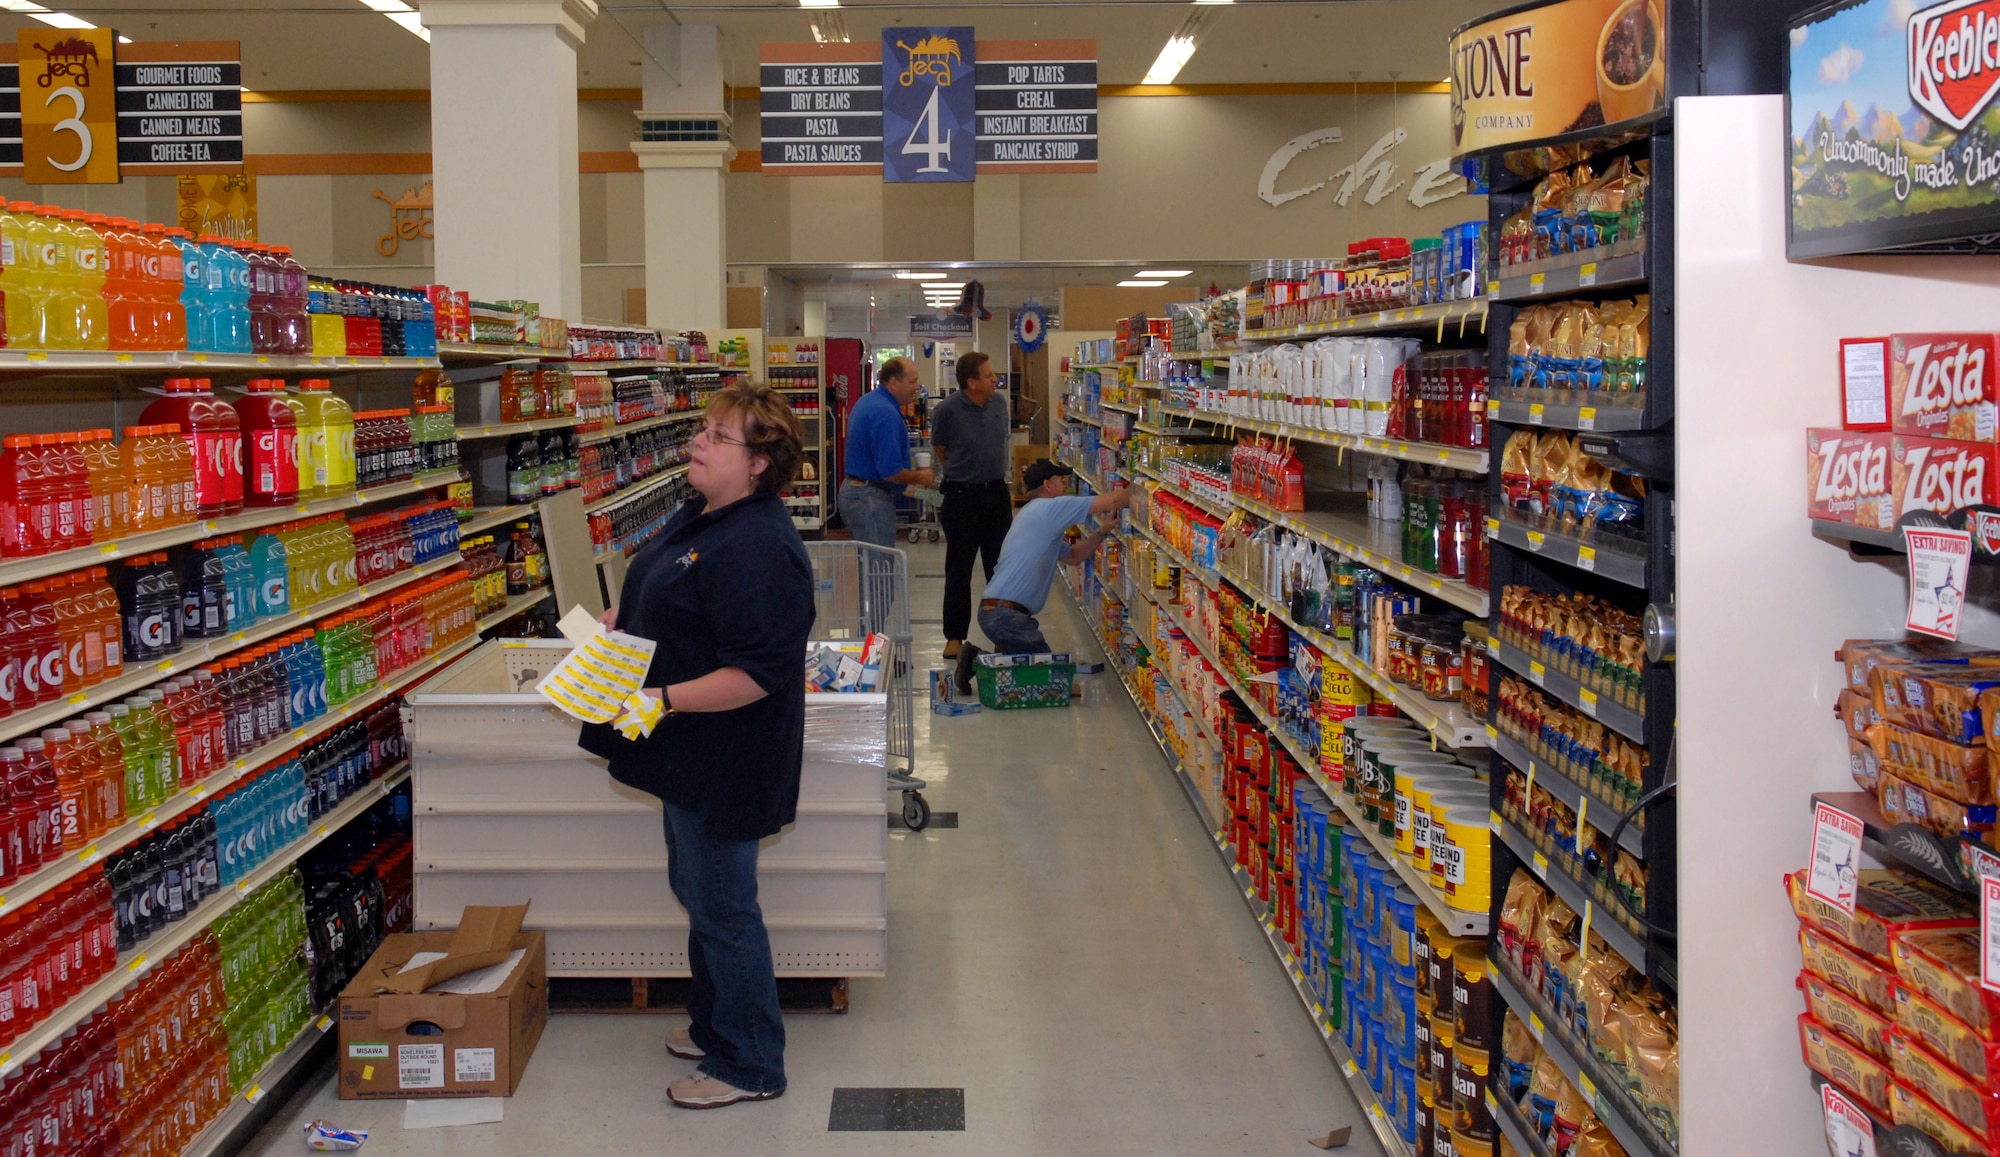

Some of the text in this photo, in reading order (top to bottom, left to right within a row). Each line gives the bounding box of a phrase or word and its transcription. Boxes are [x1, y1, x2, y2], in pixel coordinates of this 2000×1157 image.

[136, 66, 221, 85] GOURMET FOODS
[784, 67, 859, 85] RICE & BEANS
[1008, 66, 1064, 83] POP TARTS
[146, 93, 213, 110] CANNED FISH
[791, 93, 850, 110] DRY BEANS
[1016, 91, 1055, 109] CEREAL
[45, 86, 93, 171] 3
[140, 118, 221, 135] CANNED MEATS
[805, 119, 838, 136] PASTA
[901, 85, 951, 173] 4
[984, 116, 1088, 134] INSTANT BREAKFAST
[1475, 114, 1533, 129] COMPANY
[151, 143, 211, 161] COFFEE-TEA
[785, 144, 862, 162] PASTA SAUCES
[994, 142, 1079, 161] PANCAKE SYRUP
[1820, 131, 1910, 201] Uncommonly
[1915, 150, 1958, 188] made.
[914, 321, 970, 331] Self Checkout
[1902, 343, 1985, 417] Zesta
[259, 435, 274, 451] G
[1816, 438, 1887, 502] Zesta
[1901, 446, 1986, 515] Zesta
[1912, 536, 1967, 555] EXTRA SAVINGS
[262, 578, 286, 605] G
[183, 597, 200, 627] G
[140, 614, 163, 647] G
[40, 650, 63, 686] G
[1820, 810, 1840, 830] EXTRA
[356, 1047, 383, 1055] MISAWA
[1453, 1070, 1477, 1099] ban
